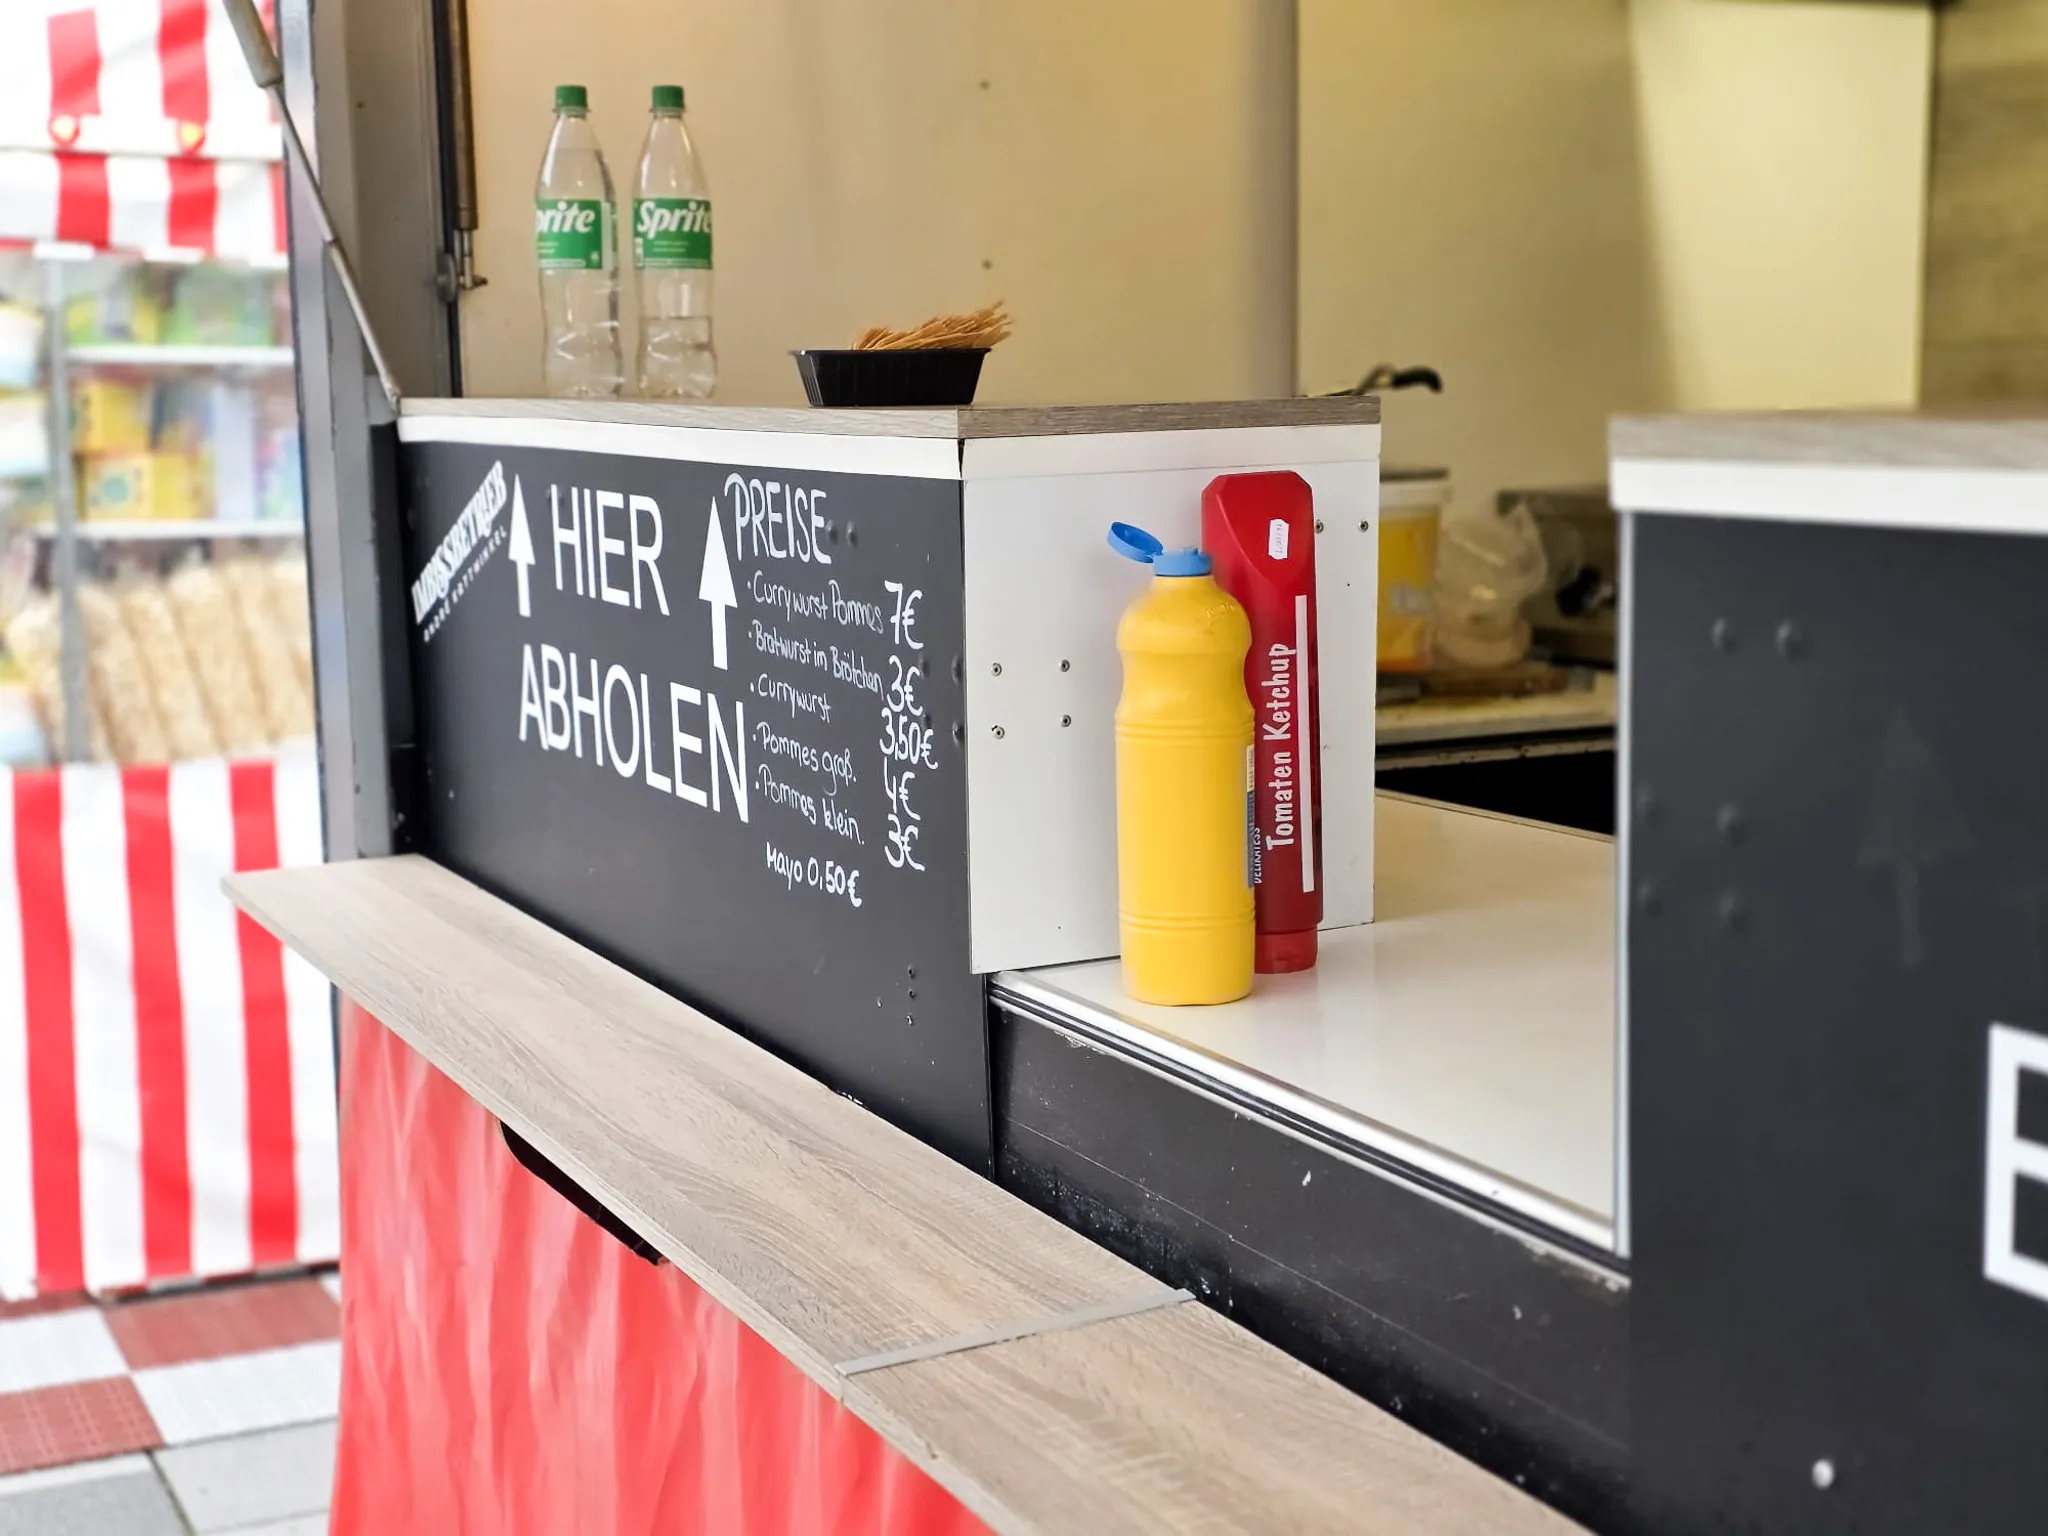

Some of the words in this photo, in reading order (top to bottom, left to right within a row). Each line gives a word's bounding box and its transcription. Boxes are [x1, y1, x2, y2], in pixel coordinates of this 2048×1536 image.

[550, 483, 671, 616] HIER
[724, 472, 832, 565] PREISE
[828, 579, 884, 634] Pommes
[884, 580, 924, 650] 7€
[829, 645, 884, 701] Brötchen
[886, 654, 924, 716] 3€
[1261, 643, 1297, 741] Ketchup
[518, 643, 749, 824] ABHOLEN
[757, 721, 819, 772] Pommes
[883, 756, 922, 821] 4€
[879, 707, 939, 769] 3,50€
[759, 765, 817, 825] Pommes
[884, 813, 926, 872] 3€
[1264, 751, 1295, 851] Tomaten
[766, 841, 802, 890] Mayo
[807, 856, 863, 908] 0,50€
